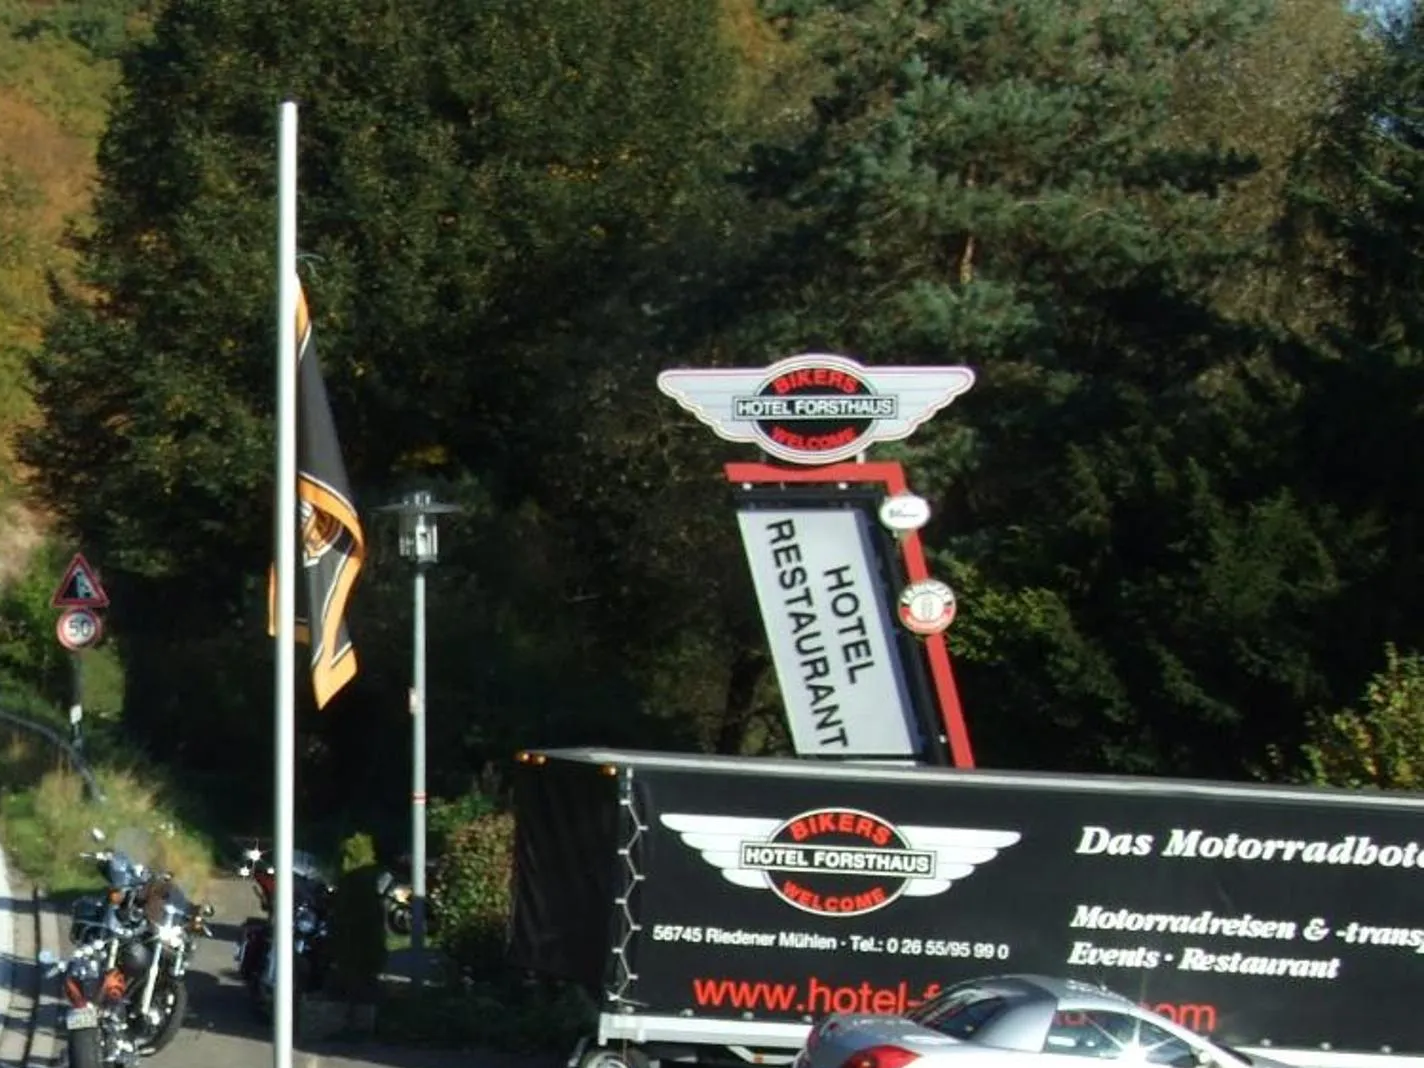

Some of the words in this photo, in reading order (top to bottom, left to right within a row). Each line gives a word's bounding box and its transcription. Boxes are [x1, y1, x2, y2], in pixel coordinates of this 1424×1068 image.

[774, 368, 858, 395] BIKERS
[738, 400, 792, 415] HOTEL
[795, 399, 892, 415] FORSTHAUS
[772, 426, 857, 450] WELCOME
[69, 619, 93, 638] 50
[765, 518, 849, 749] RESTAURANT
[823, 563, 877, 685] HOTEL
[789, 813, 894, 847] BIKERS
[1075, 826, 1154, 857] Das
[745, 847, 810, 868] HOTEL
[813, 850, 931, 873] FORSTHAUS
[782, 880, 887, 912] WELCOME
[1070, 904, 1296, 941] Motorradreisen
[1303, 917, 1330, 941] &
[652, 924, 703, 943] 56745
[705, 927, 776, 947] Riedener
[778, 930, 837, 950] Mühlen
[886, 937, 899, 953] 0
[901, 938, 922, 955] 26
[997, 943, 1009, 960] 0
[1067, 941, 1161, 969] Events
[1177, 947, 1341, 980] Restaurant
